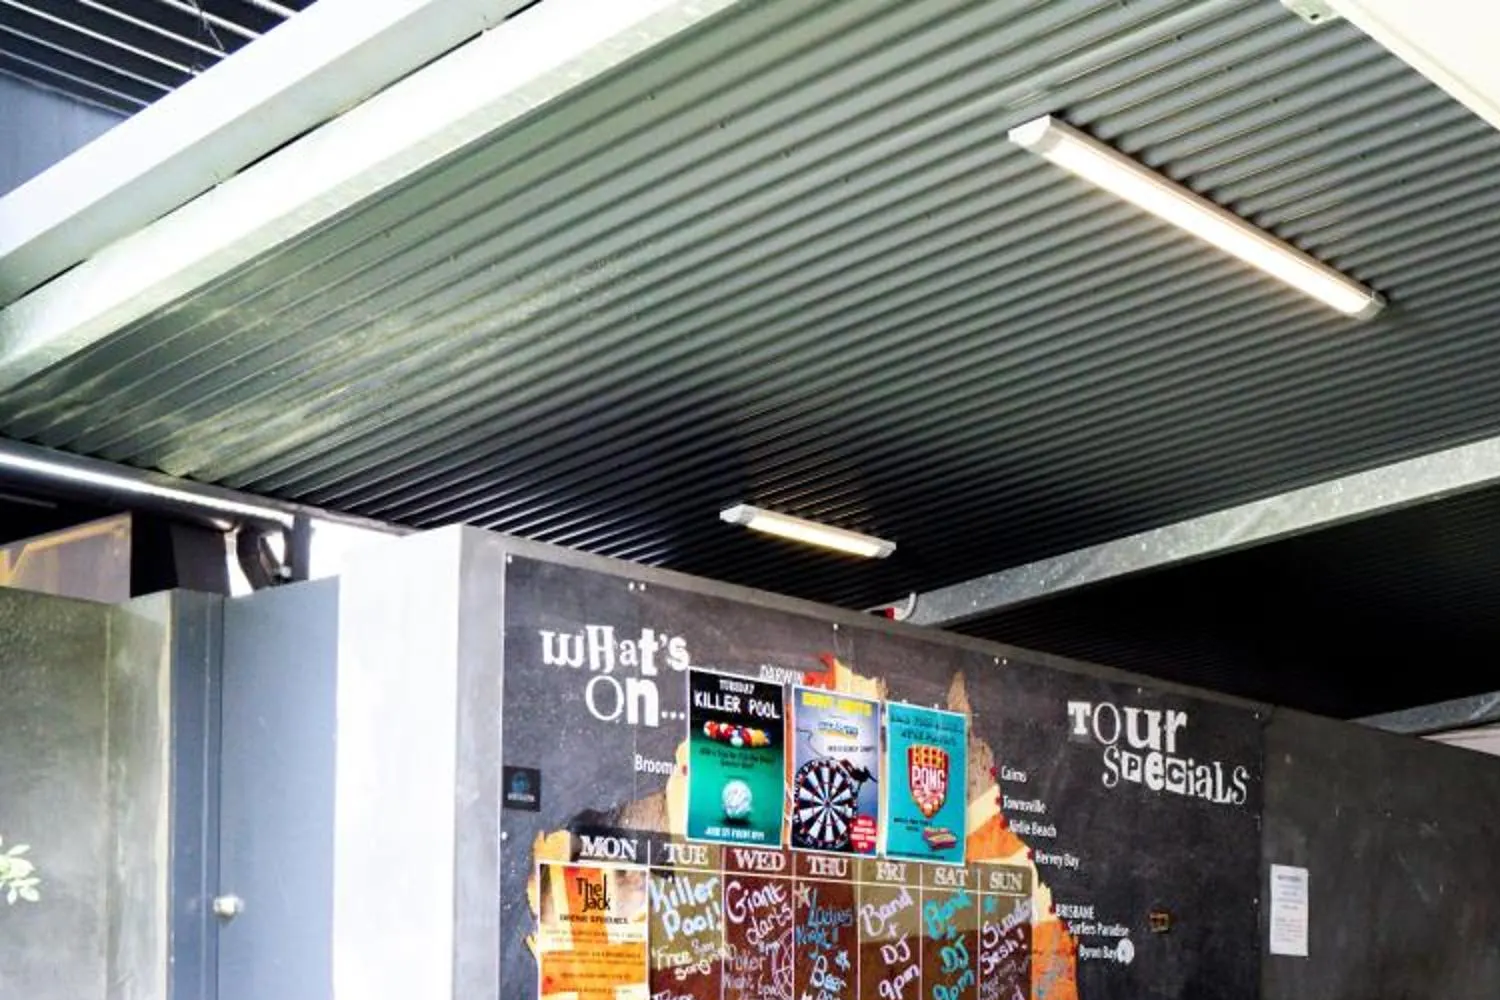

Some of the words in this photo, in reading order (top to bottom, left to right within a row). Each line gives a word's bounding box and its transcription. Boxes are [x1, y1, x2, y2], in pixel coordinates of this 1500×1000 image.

[694, 690, 741, 714] KILLER
[748, 698, 781, 719] POOL
[913, 744, 945, 769] BEER
[911, 764, 945, 793] PONG
[1001, 765, 1027, 783] Cairns
[1003, 794, 1046, 814] Townsville
[1030, 821, 1057, 838] Beach
[580, 834, 638, 861] MON
[664, 842, 708, 866] TUE
[734, 849, 786, 873] WED
[806, 854, 848, 877] THU
[876, 861, 907, 882] FRI
[1035, 850, 1063, 870] Hervey
[1063, 853, 1080, 872] Bay
[576, 877, 603, 895] The
[934, 866, 968, 887] SAT
[989, 870, 1023, 891] SUN
[581, 873, 611, 912] Jack
[650, 875, 720, 913] Killer
[726, 880, 787, 925] Giant
[861, 885, 914, 938] Band
[924, 887, 973, 941] Band
[1056, 902, 1095, 920] BRISBANE
[746, 902, 793, 946] darts
[1068, 921, 1096, 936] Surfers
[1097, 922, 1129, 938] Paradise
[880, 931, 911, 966] DJ
[940, 934, 969, 974] DJ
[1079, 943, 1102, 961] Byron
[879, 964, 921, 1000] 9pm
